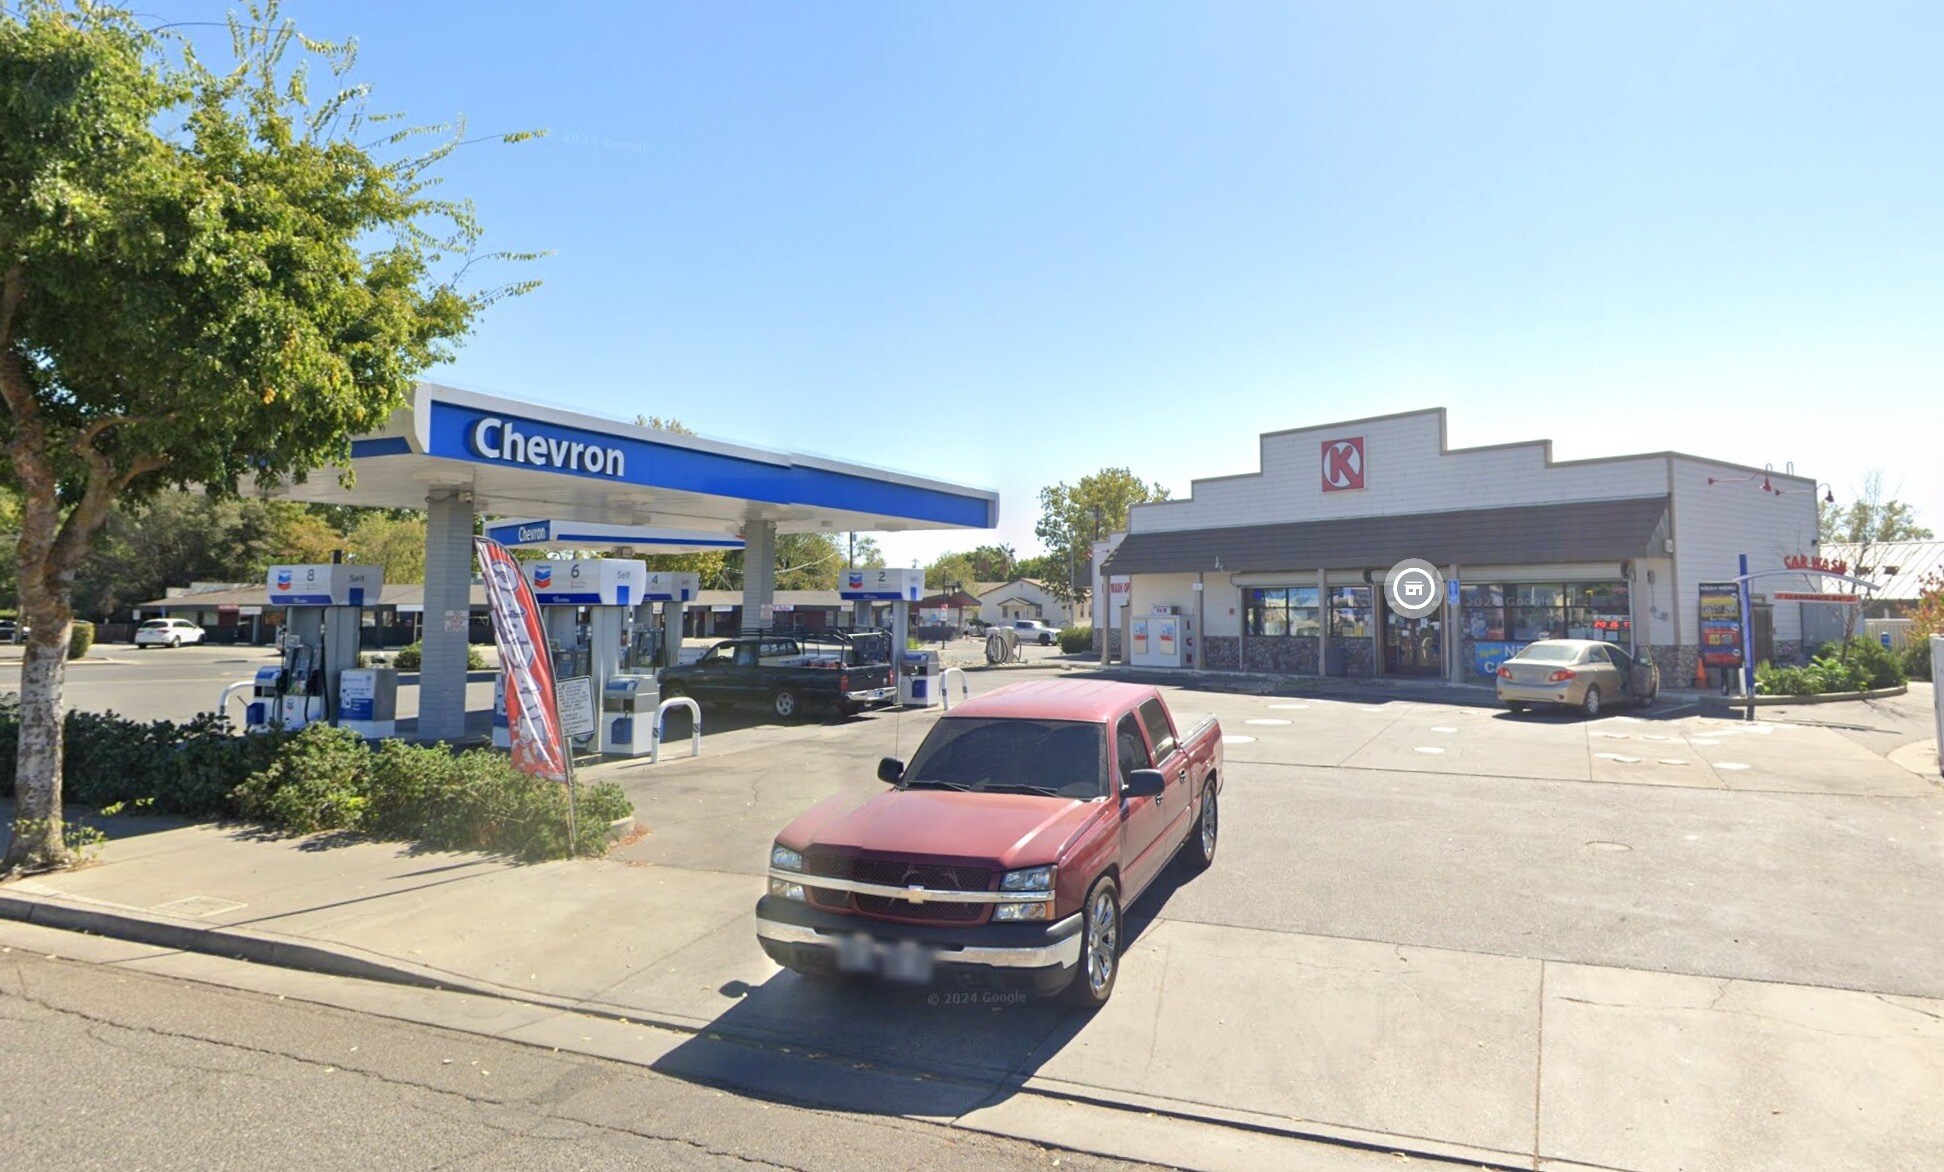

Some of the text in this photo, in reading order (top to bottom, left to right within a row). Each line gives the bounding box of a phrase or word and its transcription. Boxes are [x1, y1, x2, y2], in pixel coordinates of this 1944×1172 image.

[475, 417, 624, 477] Chevron
[518, 526, 546, 542] Chevron
[570, 563, 580, 579] 6
[1783, 553, 1847, 576] CAR WASH
[307, 568, 316, 582] 8
[350, 573, 365, 583] Self
[616, 570, 630, 580] Self
[651, 574, 658, 585] 4
[878, 571, 886, 582] 2
